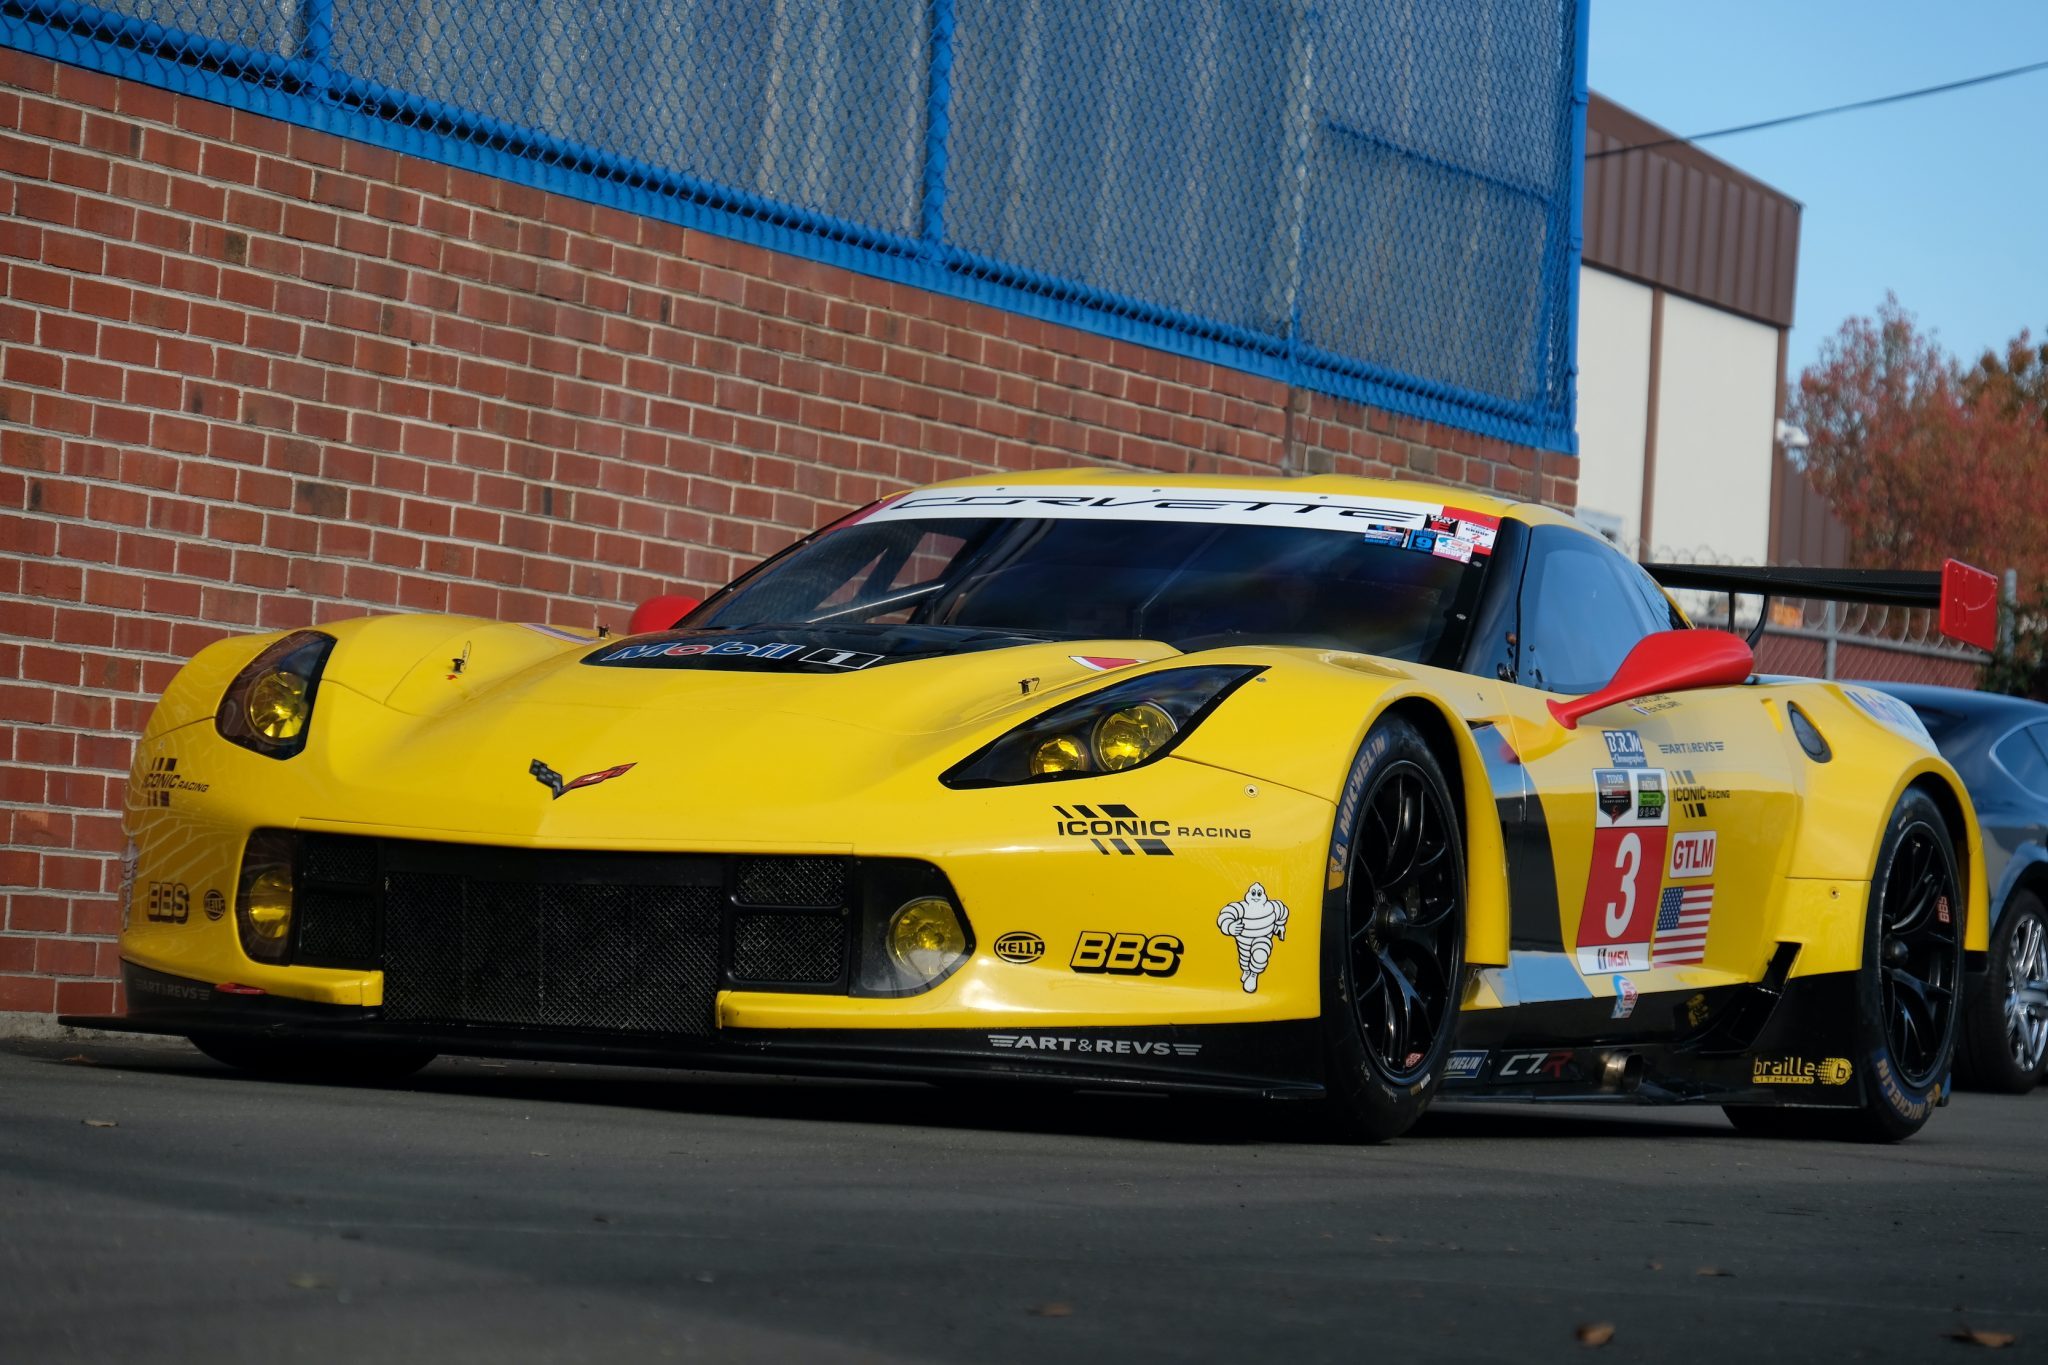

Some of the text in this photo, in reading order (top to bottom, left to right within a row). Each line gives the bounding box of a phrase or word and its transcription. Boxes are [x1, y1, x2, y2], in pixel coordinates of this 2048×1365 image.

[890, 496, 1427, 522] CORVETTE
[1415, 536, 1433, 549] 9
[601, 641, 851, 664] Mobil 1
[177, 780, 210, 793] RACING
[1340, 734, 1386, 838] MICHELIN
[1673, 786, 1706, 802] ICONIC
[1057, 820, 1252, 839] ICONIC RACING
[1673, 838, 1714, 870] GTLM
[1605, 832, 1642, 939] 3
[147, 881, 189, 925] BBS
[997, 941, 1045, 955] HELLA
[1069, 931, 1185, 978] BBS
[1015, 1035, 1171, 1056] ART&REVS
[1753, 1056, 1816, 1076] braille
